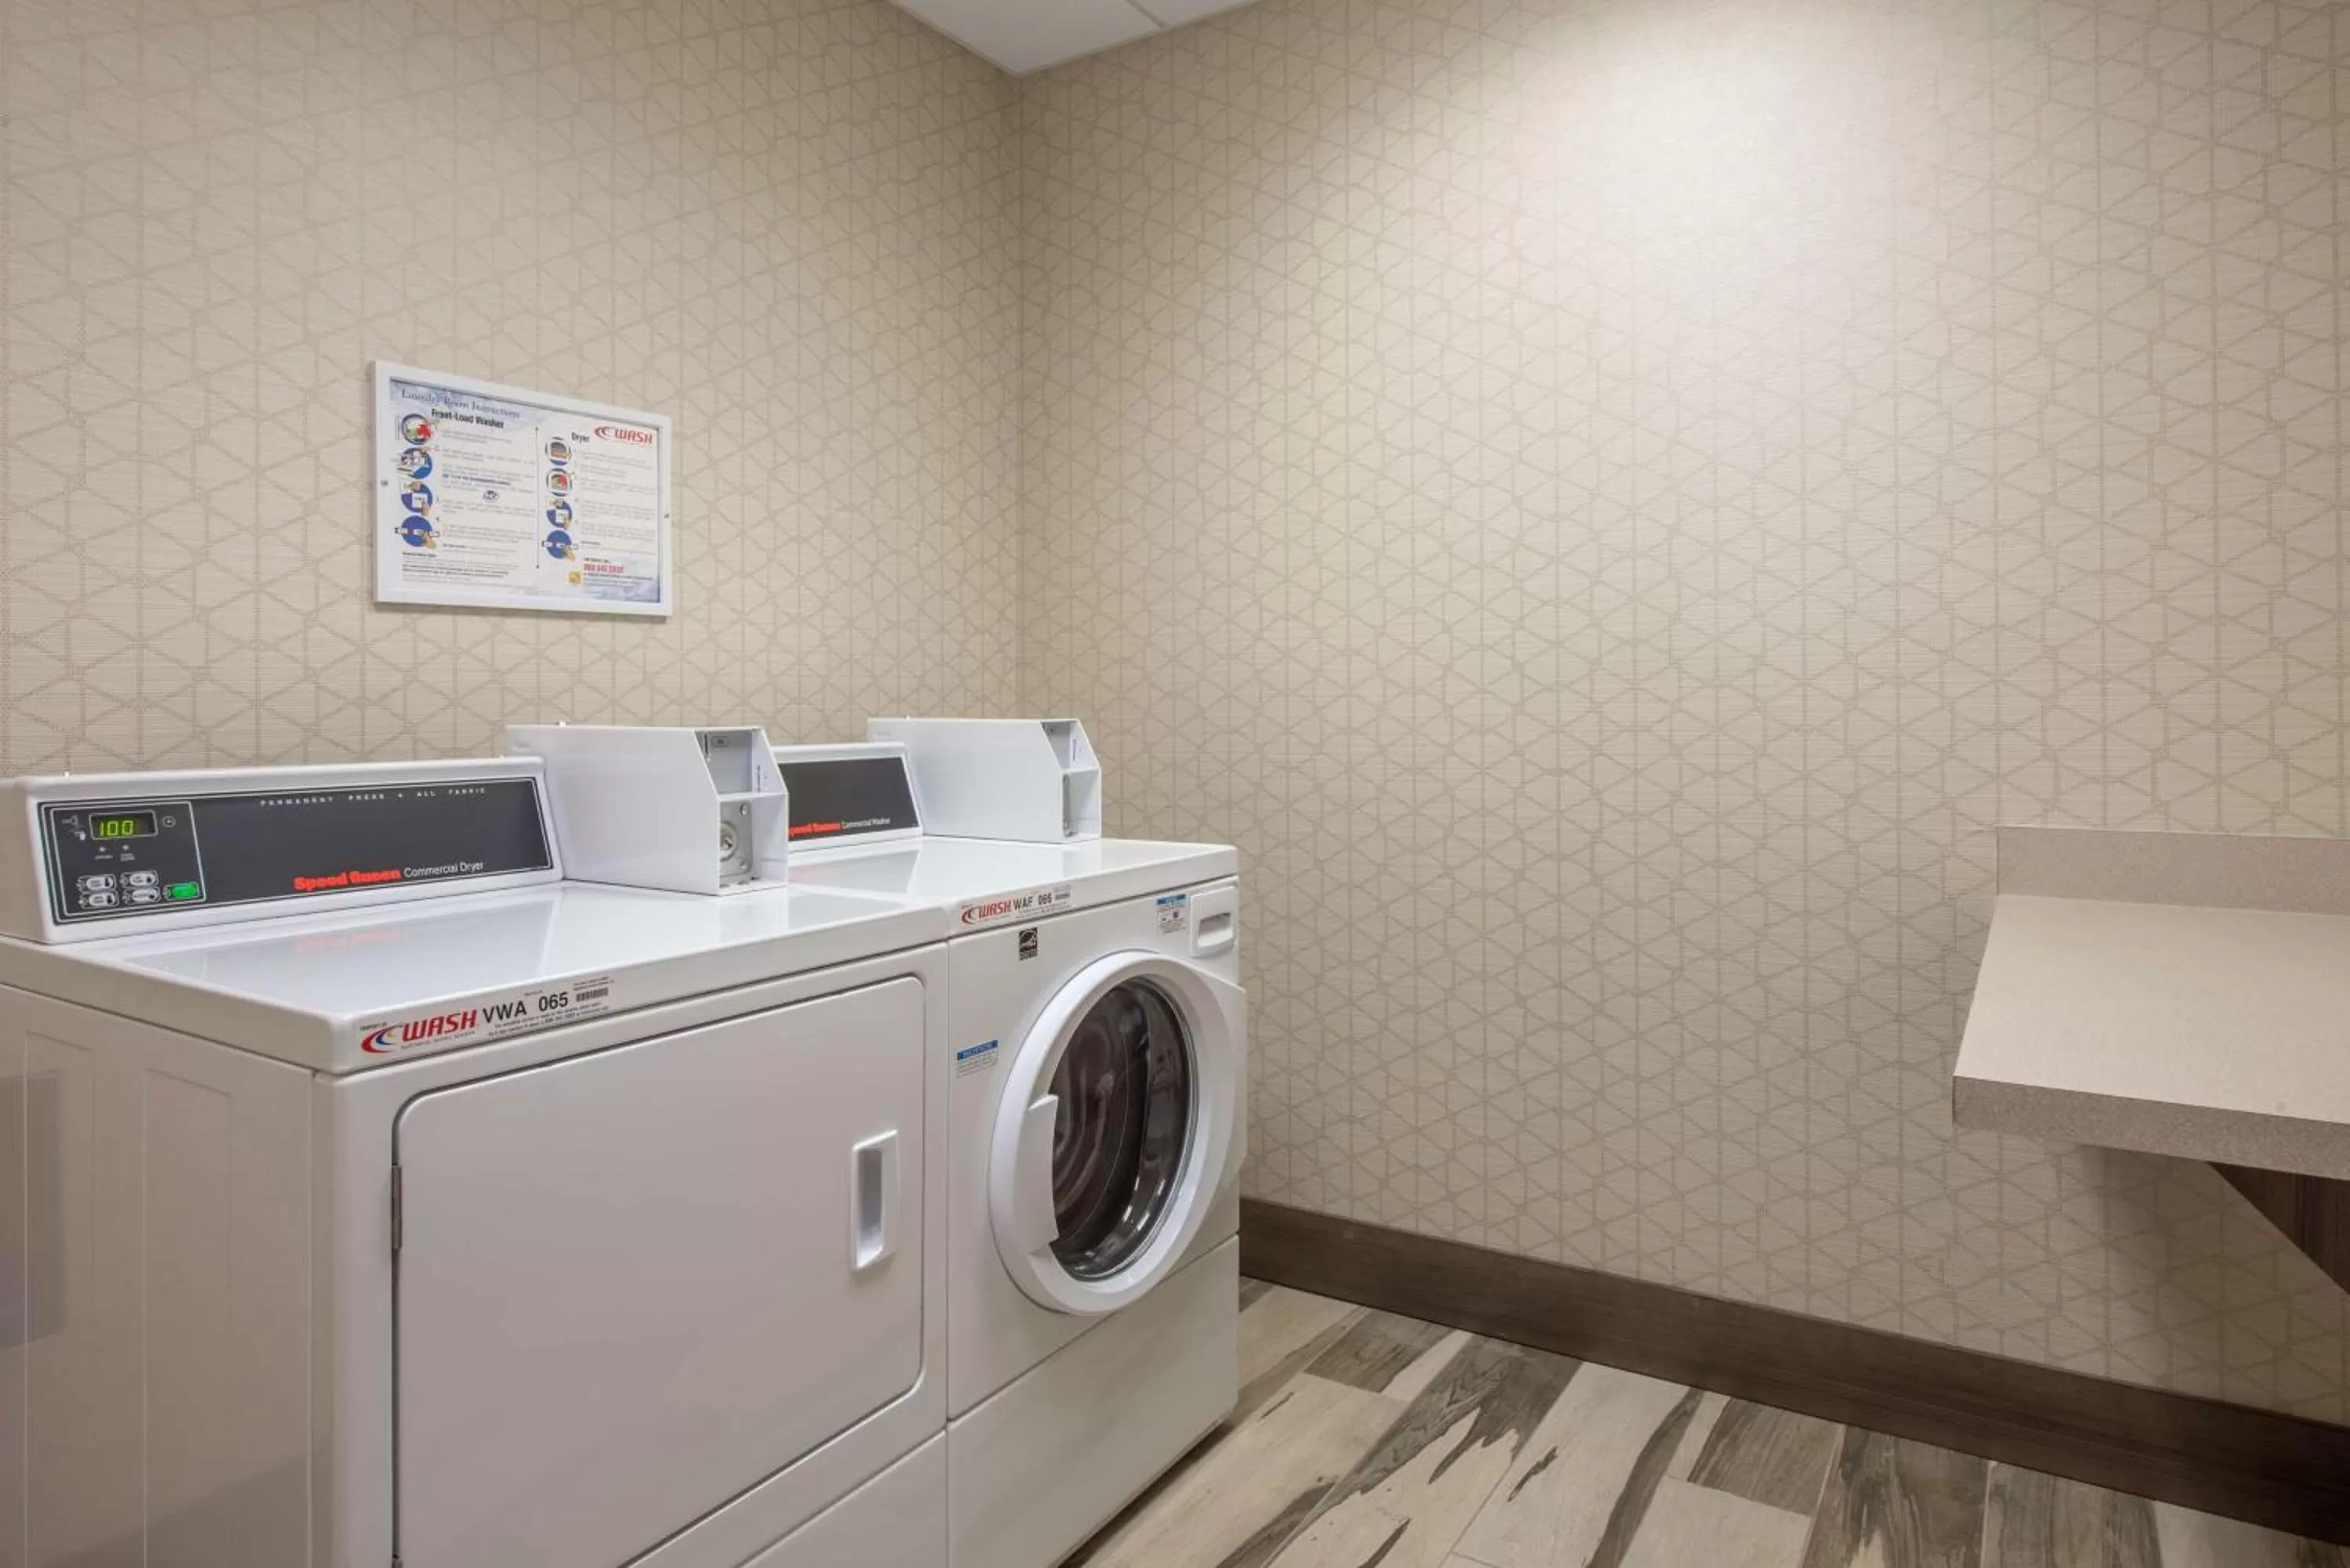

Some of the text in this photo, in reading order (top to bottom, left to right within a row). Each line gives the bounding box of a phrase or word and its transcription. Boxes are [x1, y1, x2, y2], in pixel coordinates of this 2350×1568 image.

[432, 408, 473, 424] Front-Load
[614, 428, 653, 443] WASH
[99, 820, 133, 836] 100
[294, 862, 484, 891] Speed Queen Commercial Dryer
[978, 900, 1012, 919] WASH
[1013, 895, 1033, 909] WAF
[402, 1009, 477, 1042] WASH
[483, 1000, 526, 1023] VWA
[538, 992, 569, 1012] 065
